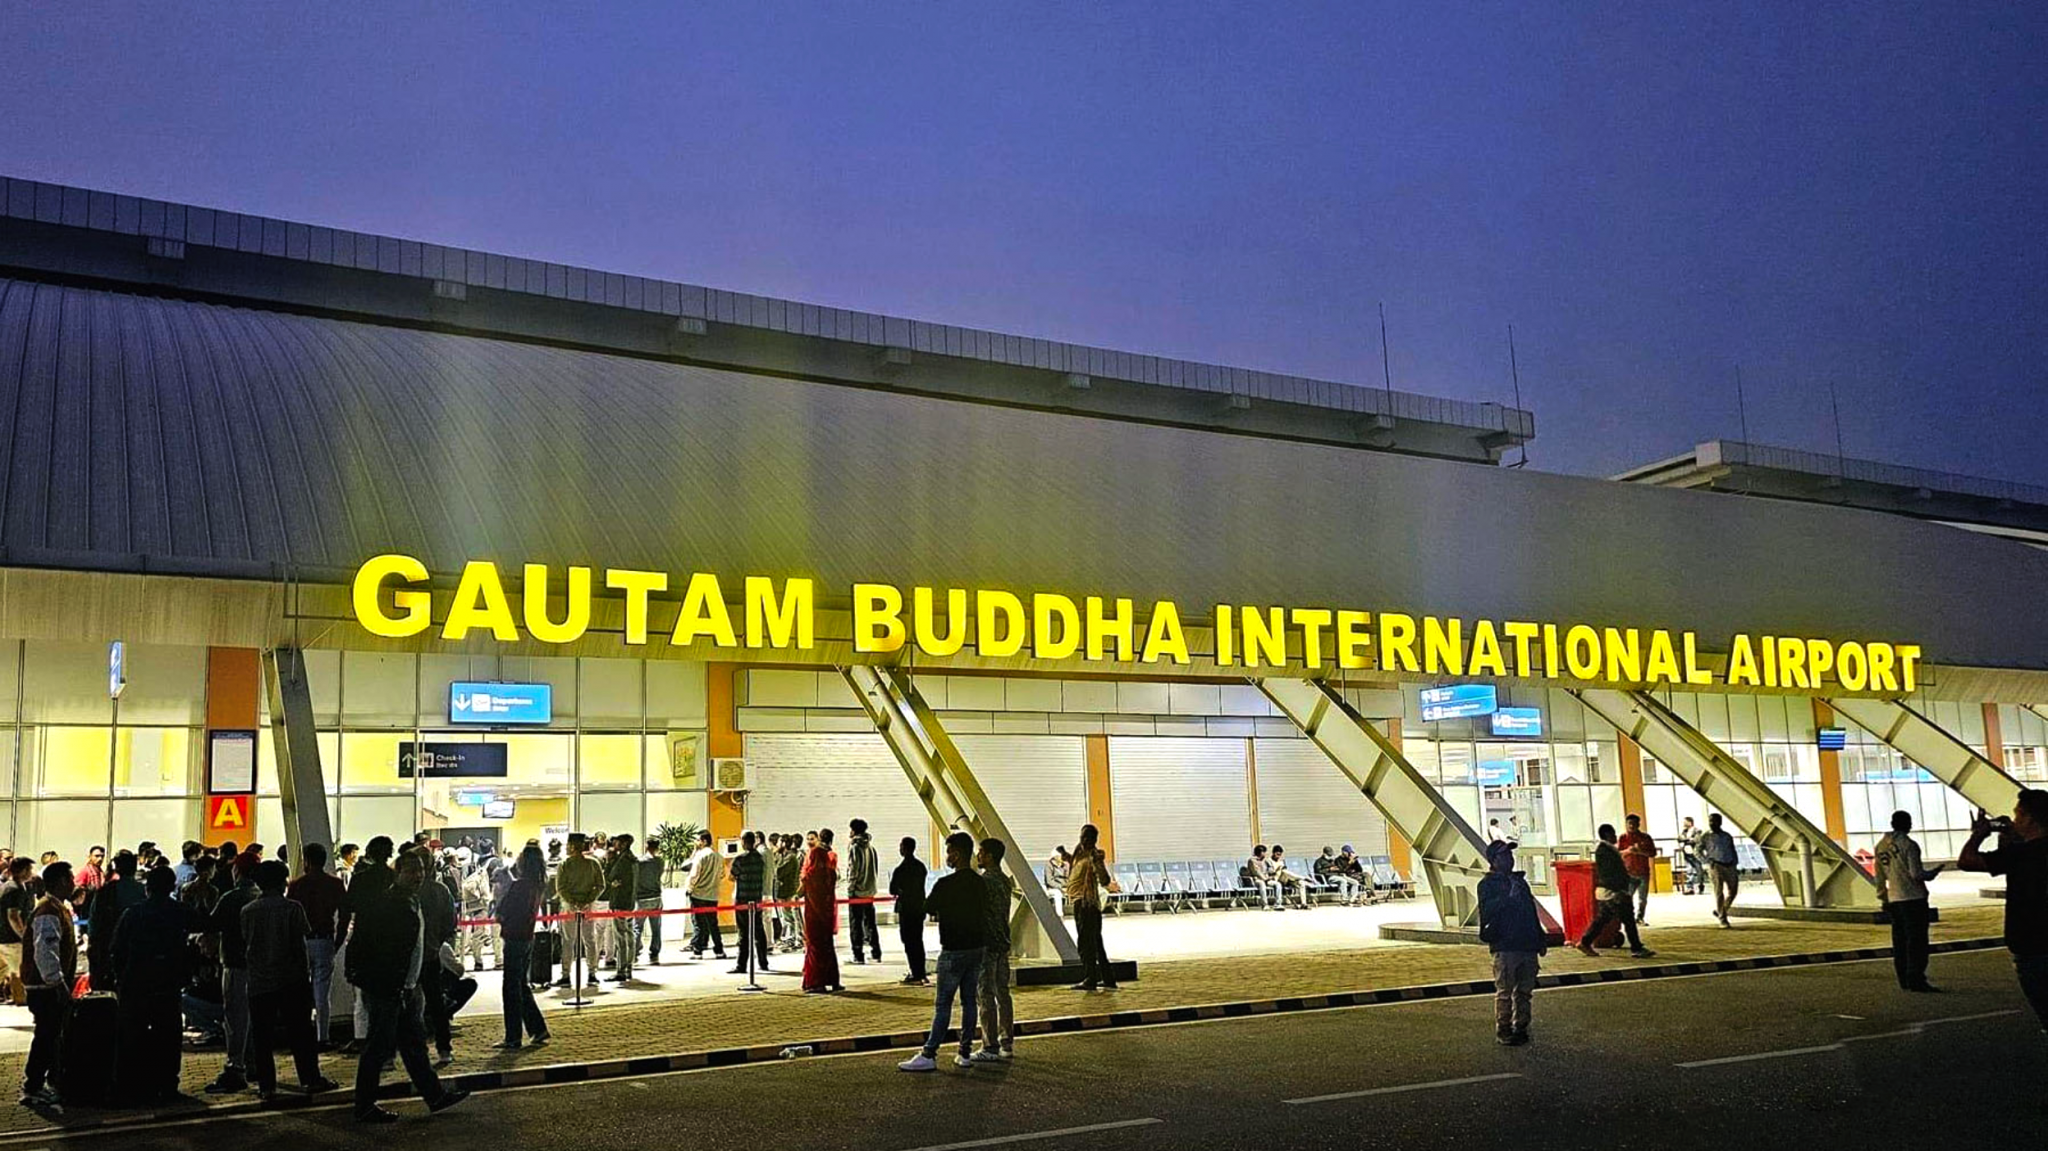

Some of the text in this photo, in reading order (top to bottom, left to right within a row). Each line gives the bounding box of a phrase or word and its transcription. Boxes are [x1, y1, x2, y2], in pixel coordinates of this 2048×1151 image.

[353, 555, 1921, 692] GAUTAM BUDDHA INTERNATIONAL AIRPORT
[213, 798, 244, 827] A
